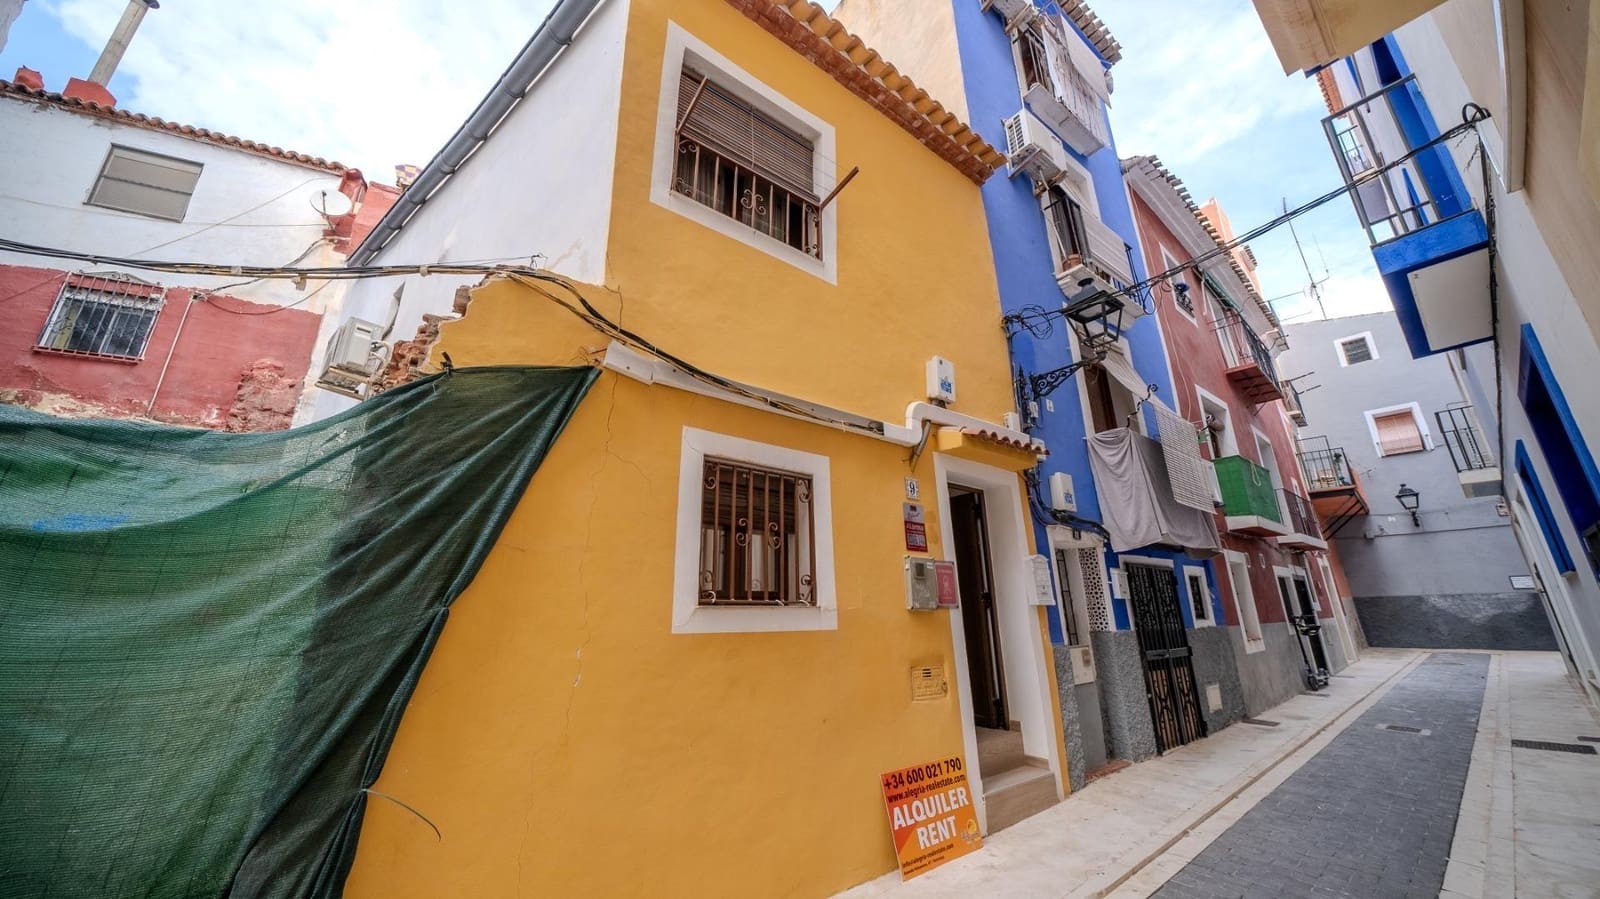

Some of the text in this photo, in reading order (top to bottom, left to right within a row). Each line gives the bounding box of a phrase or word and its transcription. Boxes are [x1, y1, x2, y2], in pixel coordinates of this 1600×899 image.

[909, 481, 916, 496] 9
[884, 757, 962, 790] +34 600 021 790
[887, 774, 966, 803] www.alegria-realestate.com
[892, 786, 969, 831] ALQUILER
[916, 816, 957, 850] RENT
